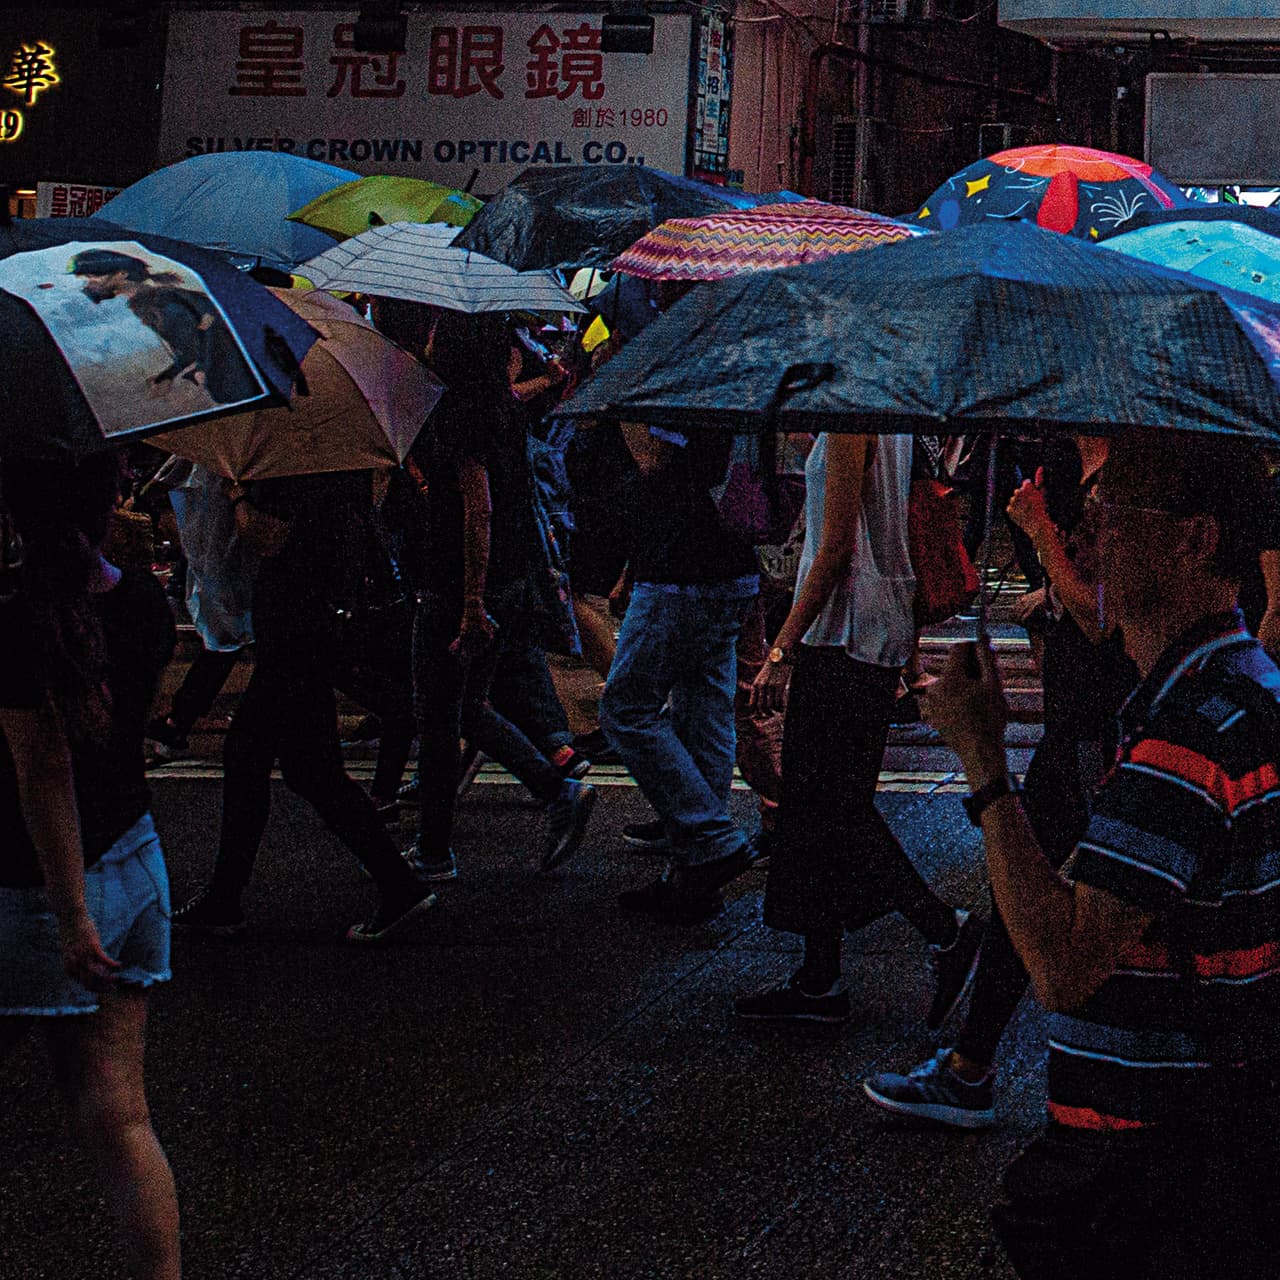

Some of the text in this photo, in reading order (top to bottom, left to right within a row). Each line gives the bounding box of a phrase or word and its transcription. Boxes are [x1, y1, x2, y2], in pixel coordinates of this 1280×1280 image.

[1, 40, 62, 106] 華
[228, 20, 606, 102] 皇冠眼鏡
[0, 109, 24, 140] 9
[570, 108, 669, 129] 創於1980
[307, 138, 422, 162] CROWN
[434, 140, 571, 164] OPTICAL
[51, 184, 121, 218] 皇冠眼
